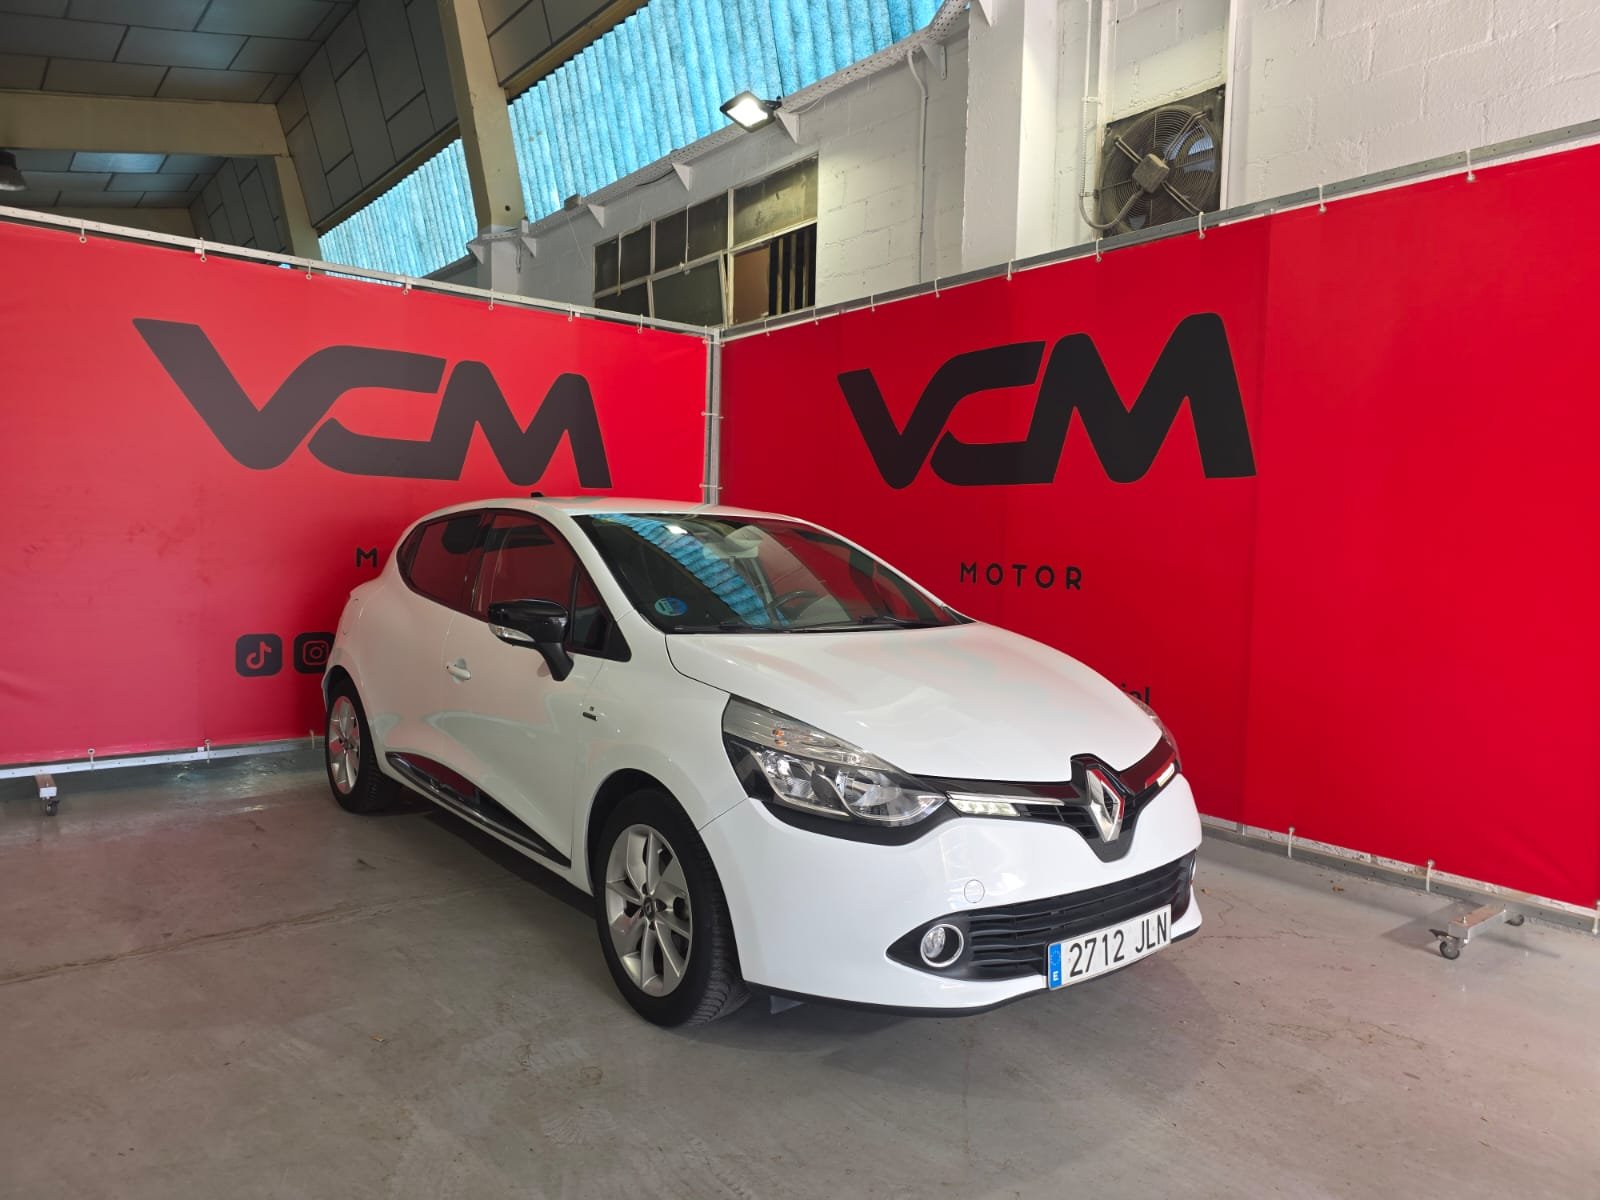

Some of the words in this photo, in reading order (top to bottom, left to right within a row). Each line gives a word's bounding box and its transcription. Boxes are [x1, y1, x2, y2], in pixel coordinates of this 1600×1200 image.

[133, 318, 612, 489] VCM
[837, 312, 1256, 489] VCM
[960, 561, 1083, 591] MOTOR
[1069, 930, 1125, 978] 2712
[1135, 911, 1167, 953] JLN
